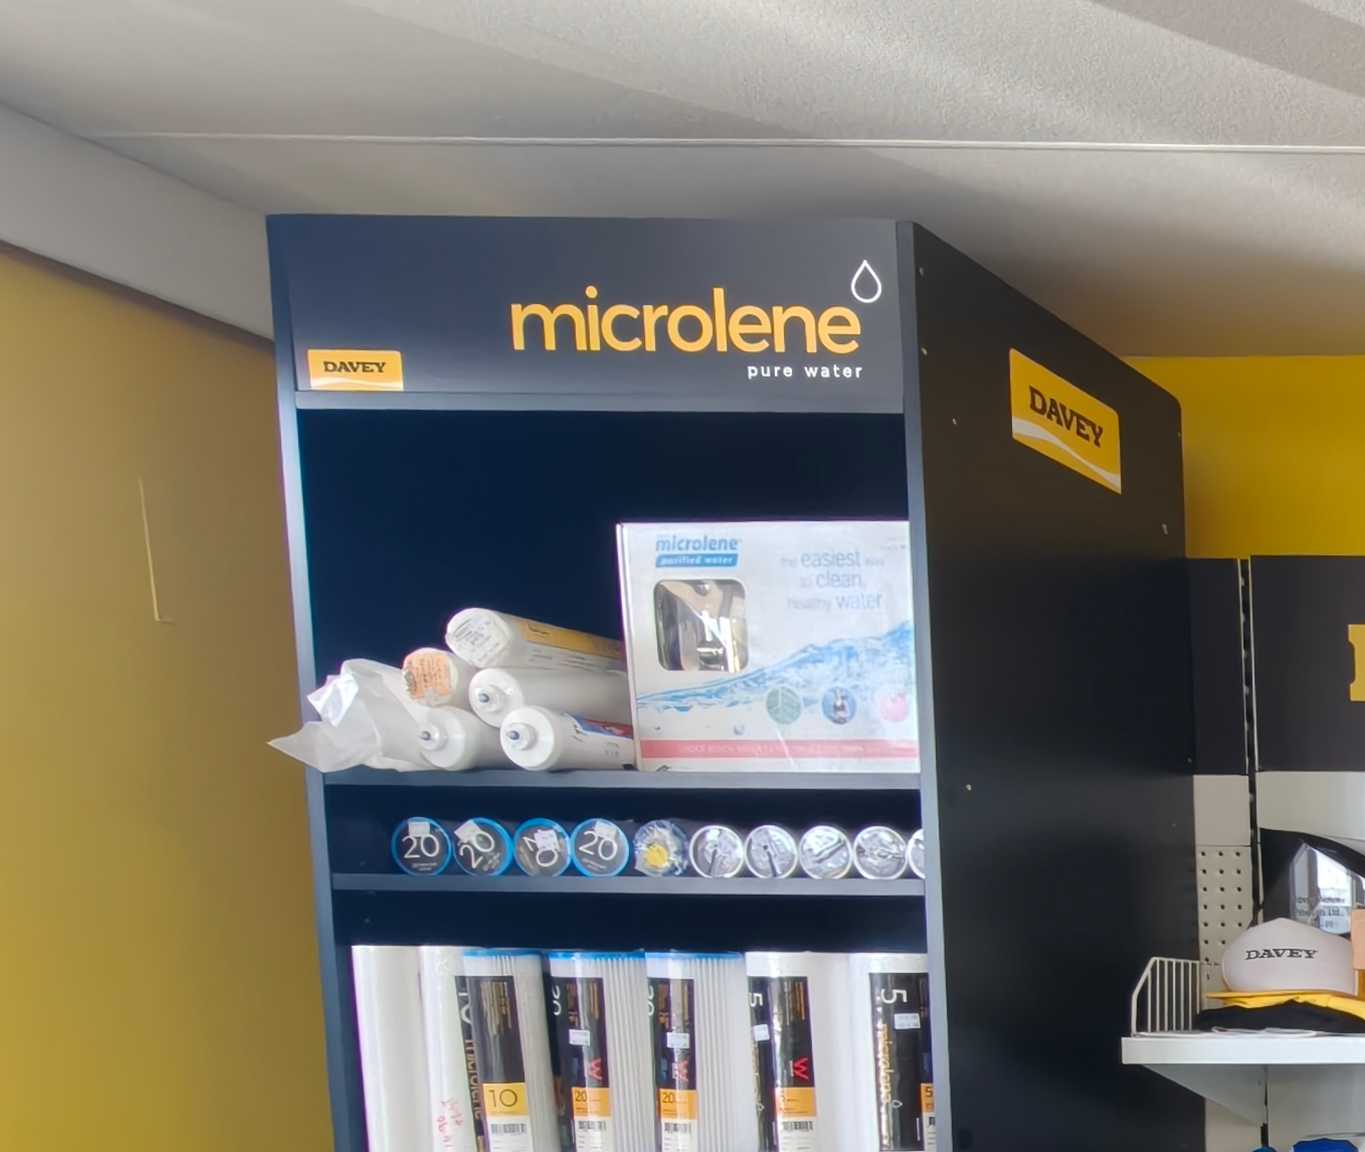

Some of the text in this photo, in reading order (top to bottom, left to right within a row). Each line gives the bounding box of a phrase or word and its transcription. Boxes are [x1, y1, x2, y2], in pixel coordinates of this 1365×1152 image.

[511, 285, 862, 354] microlene
[322, 361, 387, 375] DAVEY
[747, 363, 864, 380] pure water
[1028, 384, 1105, 450] DAVEY
[655, 536, 738, 551] microlene
[703, 556, 734, 565] water
[800, 550, 861, 567] easiest
[836, 595, 882, 609] water
[402, 834, 439, 857] 20
[460, 831, 495, 869] 20
[578, 831, 618, 861] 20
[1245, 948, 1318, 960] DAVEY
[881, 989, 908, 1004] 5
[489, 1088, 518, 1107] 10
[574, 1090, 587, 1102] 20
[662, 1092, 675, 1103] 20
